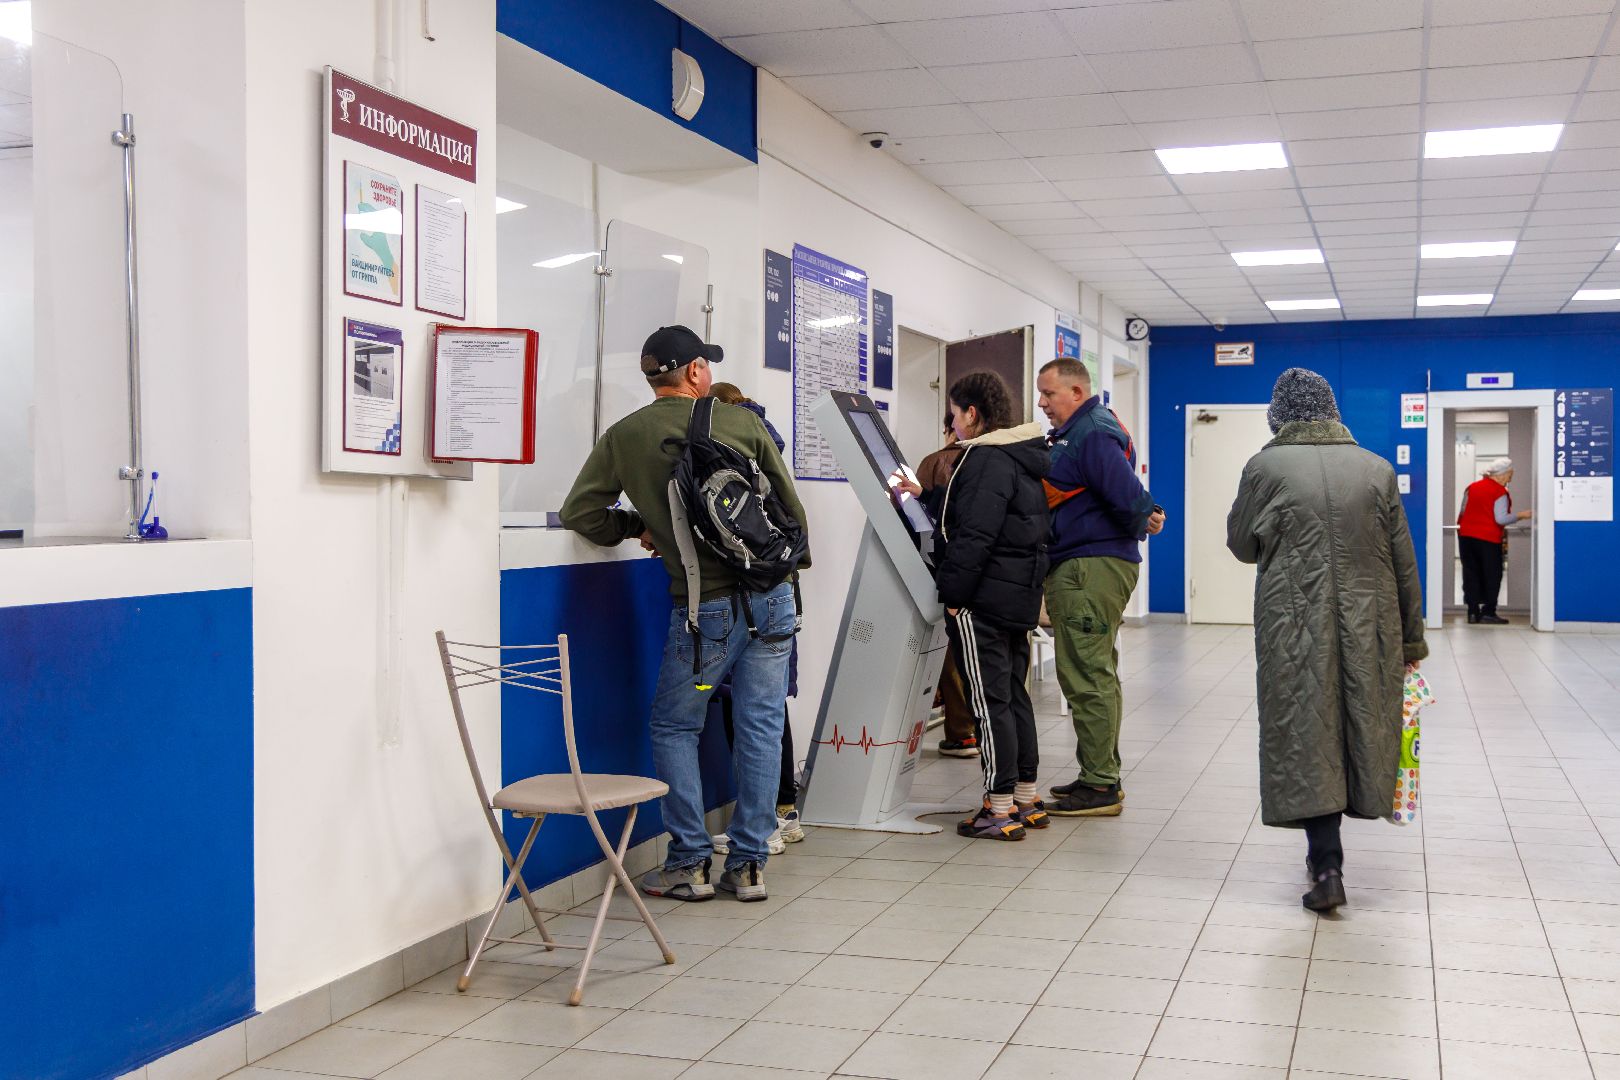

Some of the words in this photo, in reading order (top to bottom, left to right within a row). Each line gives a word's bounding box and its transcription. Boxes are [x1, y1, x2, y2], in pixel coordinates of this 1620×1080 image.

[359, 103, 472, 166] ИНФОРМАЦИЯ
[370, 179, 397, 197] СОХРАНИТЕ
[373, 191, 397, 208] ЗДОРОВЬЕ
[351, 258, 395, 278] ВАКЦИНИРУЙТЕСЬ
[351, 269, 359, 279] ОТ
[359, 271, 378, 285] ГРИППА
[1557, 392, 1566, 403] 4
[1557, 421, 1566, 433] 3
[1557, 451, 1566, 462] 2
